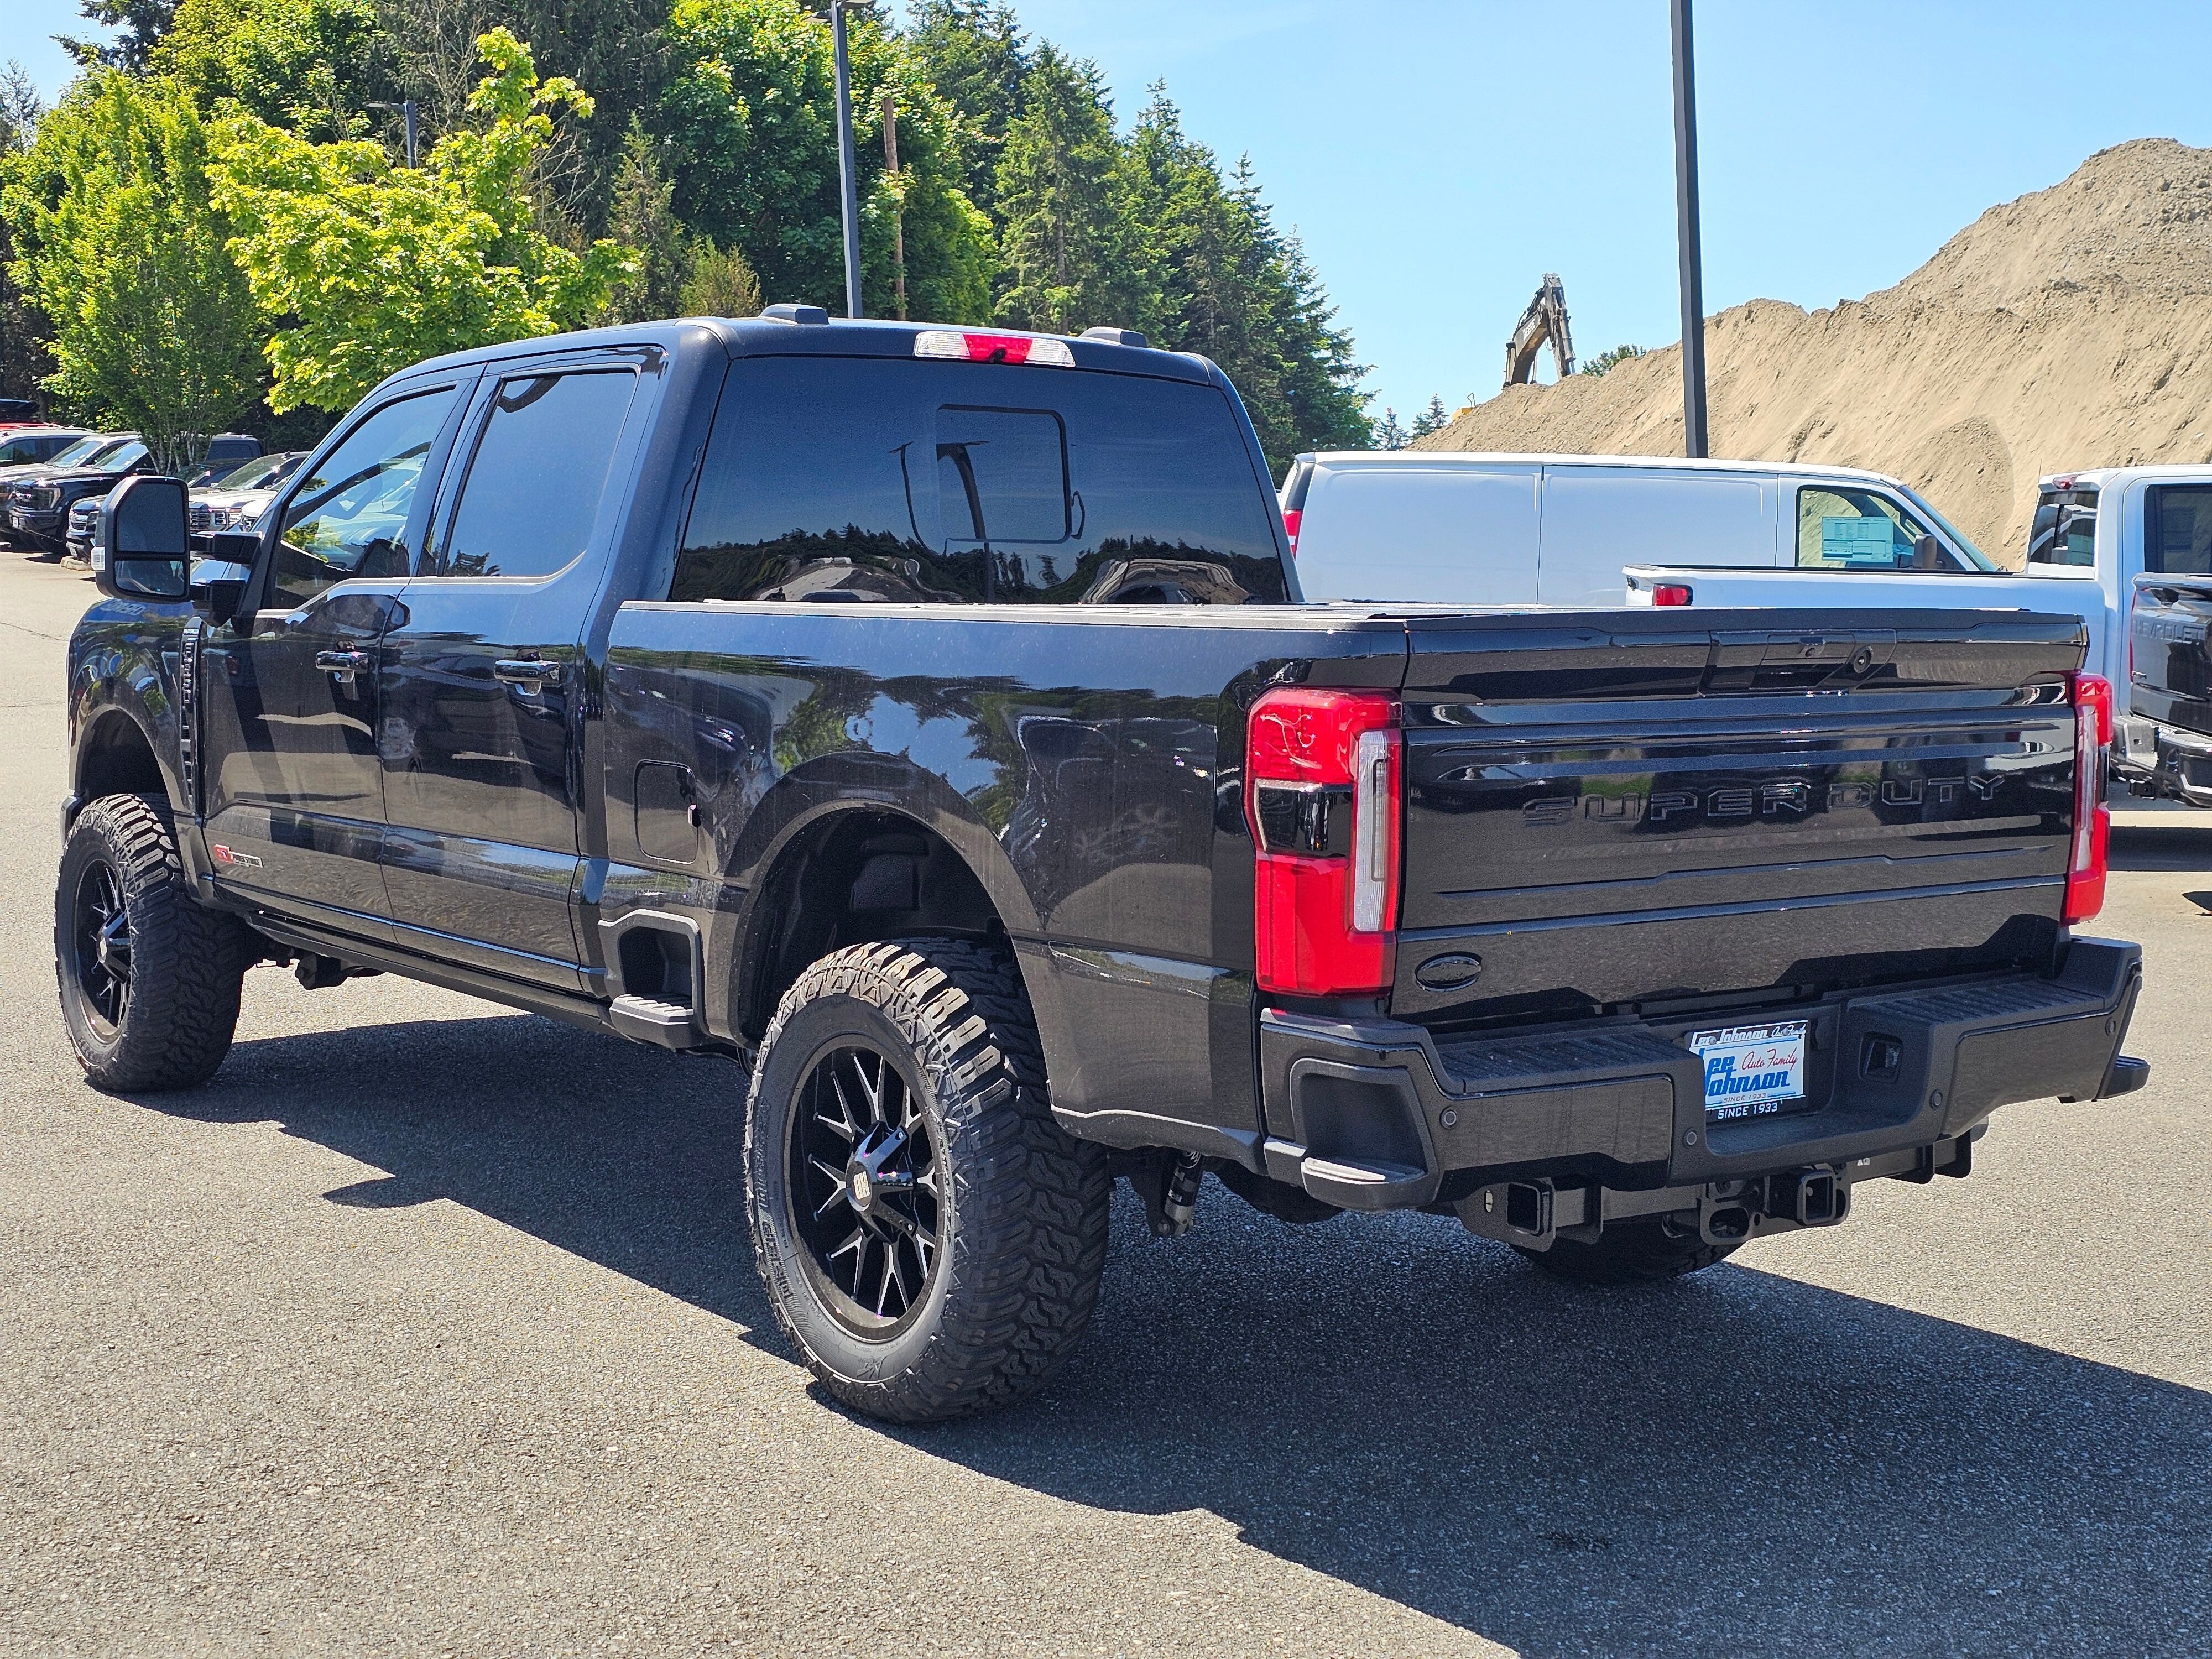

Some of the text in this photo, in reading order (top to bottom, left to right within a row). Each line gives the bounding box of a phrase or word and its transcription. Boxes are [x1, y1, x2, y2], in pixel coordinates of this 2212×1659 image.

[1522, 774, 2005, 825] SUPER DUTY
[1716, 1028, 1768, 1044] Johnson
[1698, 1048, 1737, 1074] ee
[1741, 1047, 1798, 1071] Auto Family
[1717, 1102, 1778, 1120] SINCE 1933
